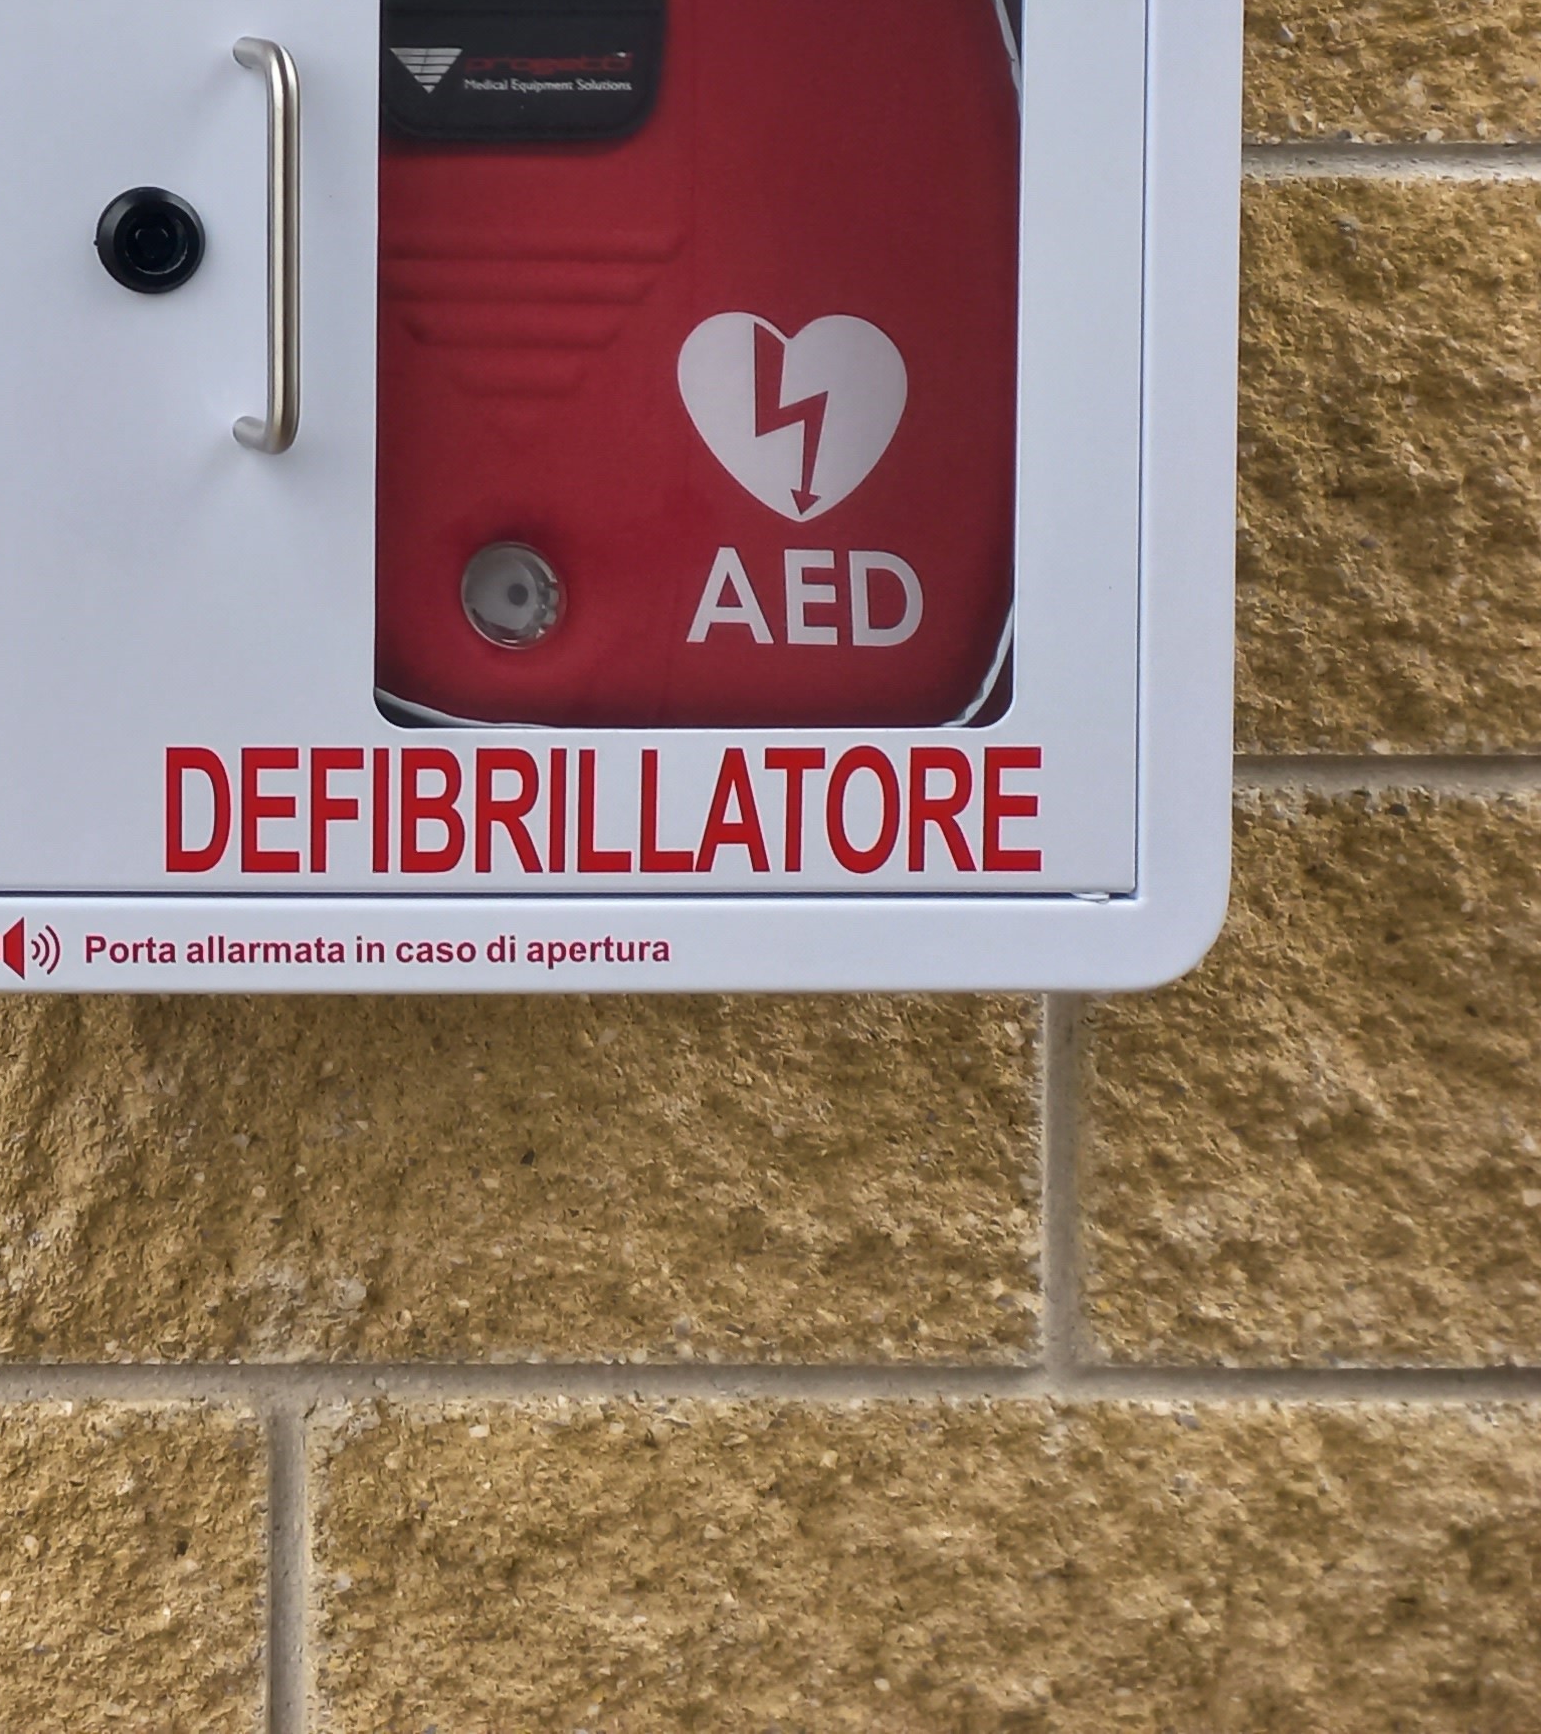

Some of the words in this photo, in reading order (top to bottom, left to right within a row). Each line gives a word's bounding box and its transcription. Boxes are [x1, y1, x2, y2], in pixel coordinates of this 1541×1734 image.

[687, 547, 923, 646] AED
[166, 746, 1041, 874] DEFIBRILLATORE
[86, 936, 176, 963] Porta
[187, 936, 344, 963] allarmata
[357, 936, 384, 962] in
[396, 942, 476, 963] caso
[487, 936, 515, 962] di
[527, 936, 669, 969] apertura
